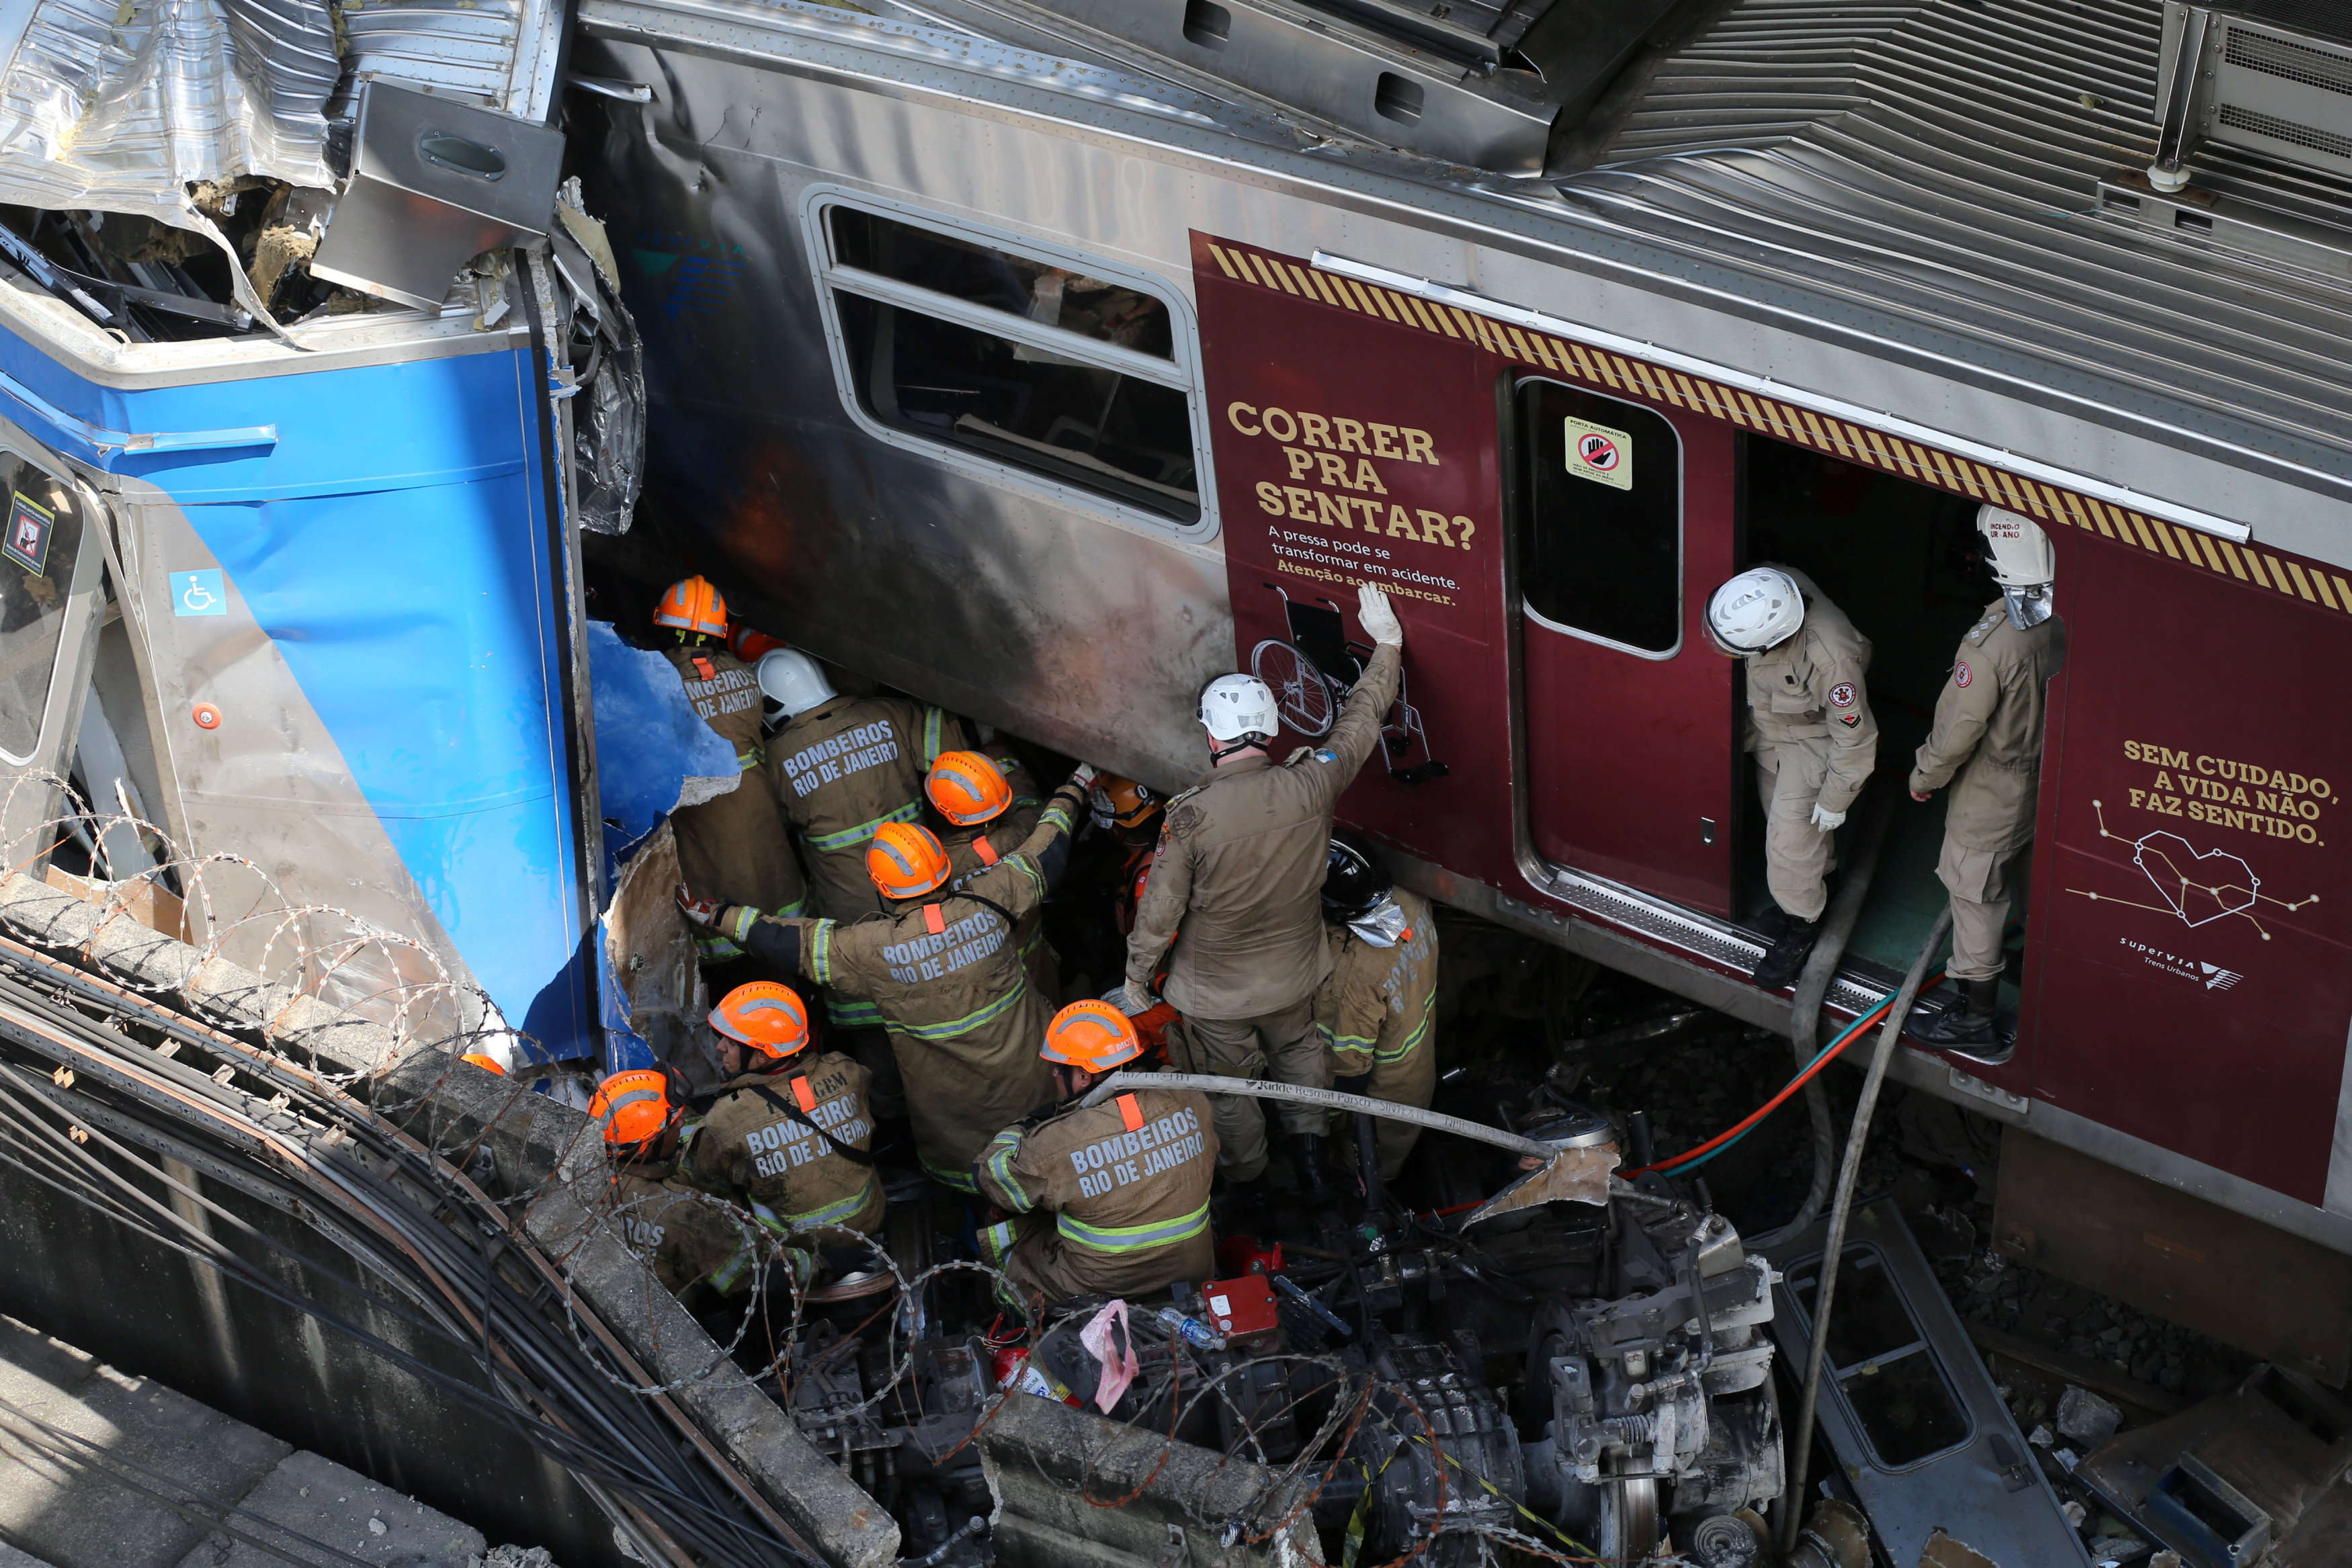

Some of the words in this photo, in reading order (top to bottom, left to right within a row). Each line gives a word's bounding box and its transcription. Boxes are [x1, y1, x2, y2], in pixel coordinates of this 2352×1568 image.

[1228, 401, 1440, 466] CORRER
[1570, 419, 1589, 428] PORTA
[1590, 425, 1627, 439] AUTOMÁTICA
[1282, 445, 1388, 494] PRA
[1255, 481, 1475, 550] SENTAR?
[1269, 525, 1280, 537] A
[1284, 529, 1329, 548] pressa
[1333, 539, 1371, 556] pode
[1375, 548, 1391, 560] se
[1271, 542, 1359, 570] transformar
[1363, 563, 1387, 575] em
[1391, 568, 1461, 590] acidente.
[1277, 559, 1343, 582] Atenção
[1346, 575, 1364, 586] ao
[696, 699, 718, 720] DE
[719, 687, 760, 714] JANEIRO
[782, 720, 893, 779] BOMBEIROS
[792, 771, 819, 797] RIO
[818, 760, 842, 783] DE
[843, 741, 898, 775] JANEIRO
[2124, 740, 2189, 771] SEM
[2196, 754, 2339, 805] CUIDADO,
[2128, 788, 2183, 817] FAZ
[2188, 800, 2324, 846] SENTIDO.
[2154, 771, 2174, 791] A
[2178, 774, 2251, 807] VIDA
[2256, 791, 2320, 820] NÃO
[883, 907, 999, 965] BOMBEIROS
[890, 965, 919, 984] RIO
[919, 957, 943, 981] DE
[947, 928, 1005, 972] JANEIRO
[2144, 957, 2165, 969] Trens
[2167, 965, 2199, 982] Urbanos
[812, 1072, 849, 1099] GBM
[1260, 1081, 1292, 1093] Kidde
[1296, 1086, 1335, 1101] Resmat
[1338, 1092, 1371, 1108] Parsch
[755, 1150, 788, 1178] RIO
[788, 1141, 814, 1167] DE
[1070, 1106, 1199, 1175] BOMBEIROS
[1079, 1170, 1112, 1199] RIO
[1114, 1160, 1141, 1186] DE
[1144, 1131, 1205, 1176] JANEIRO
